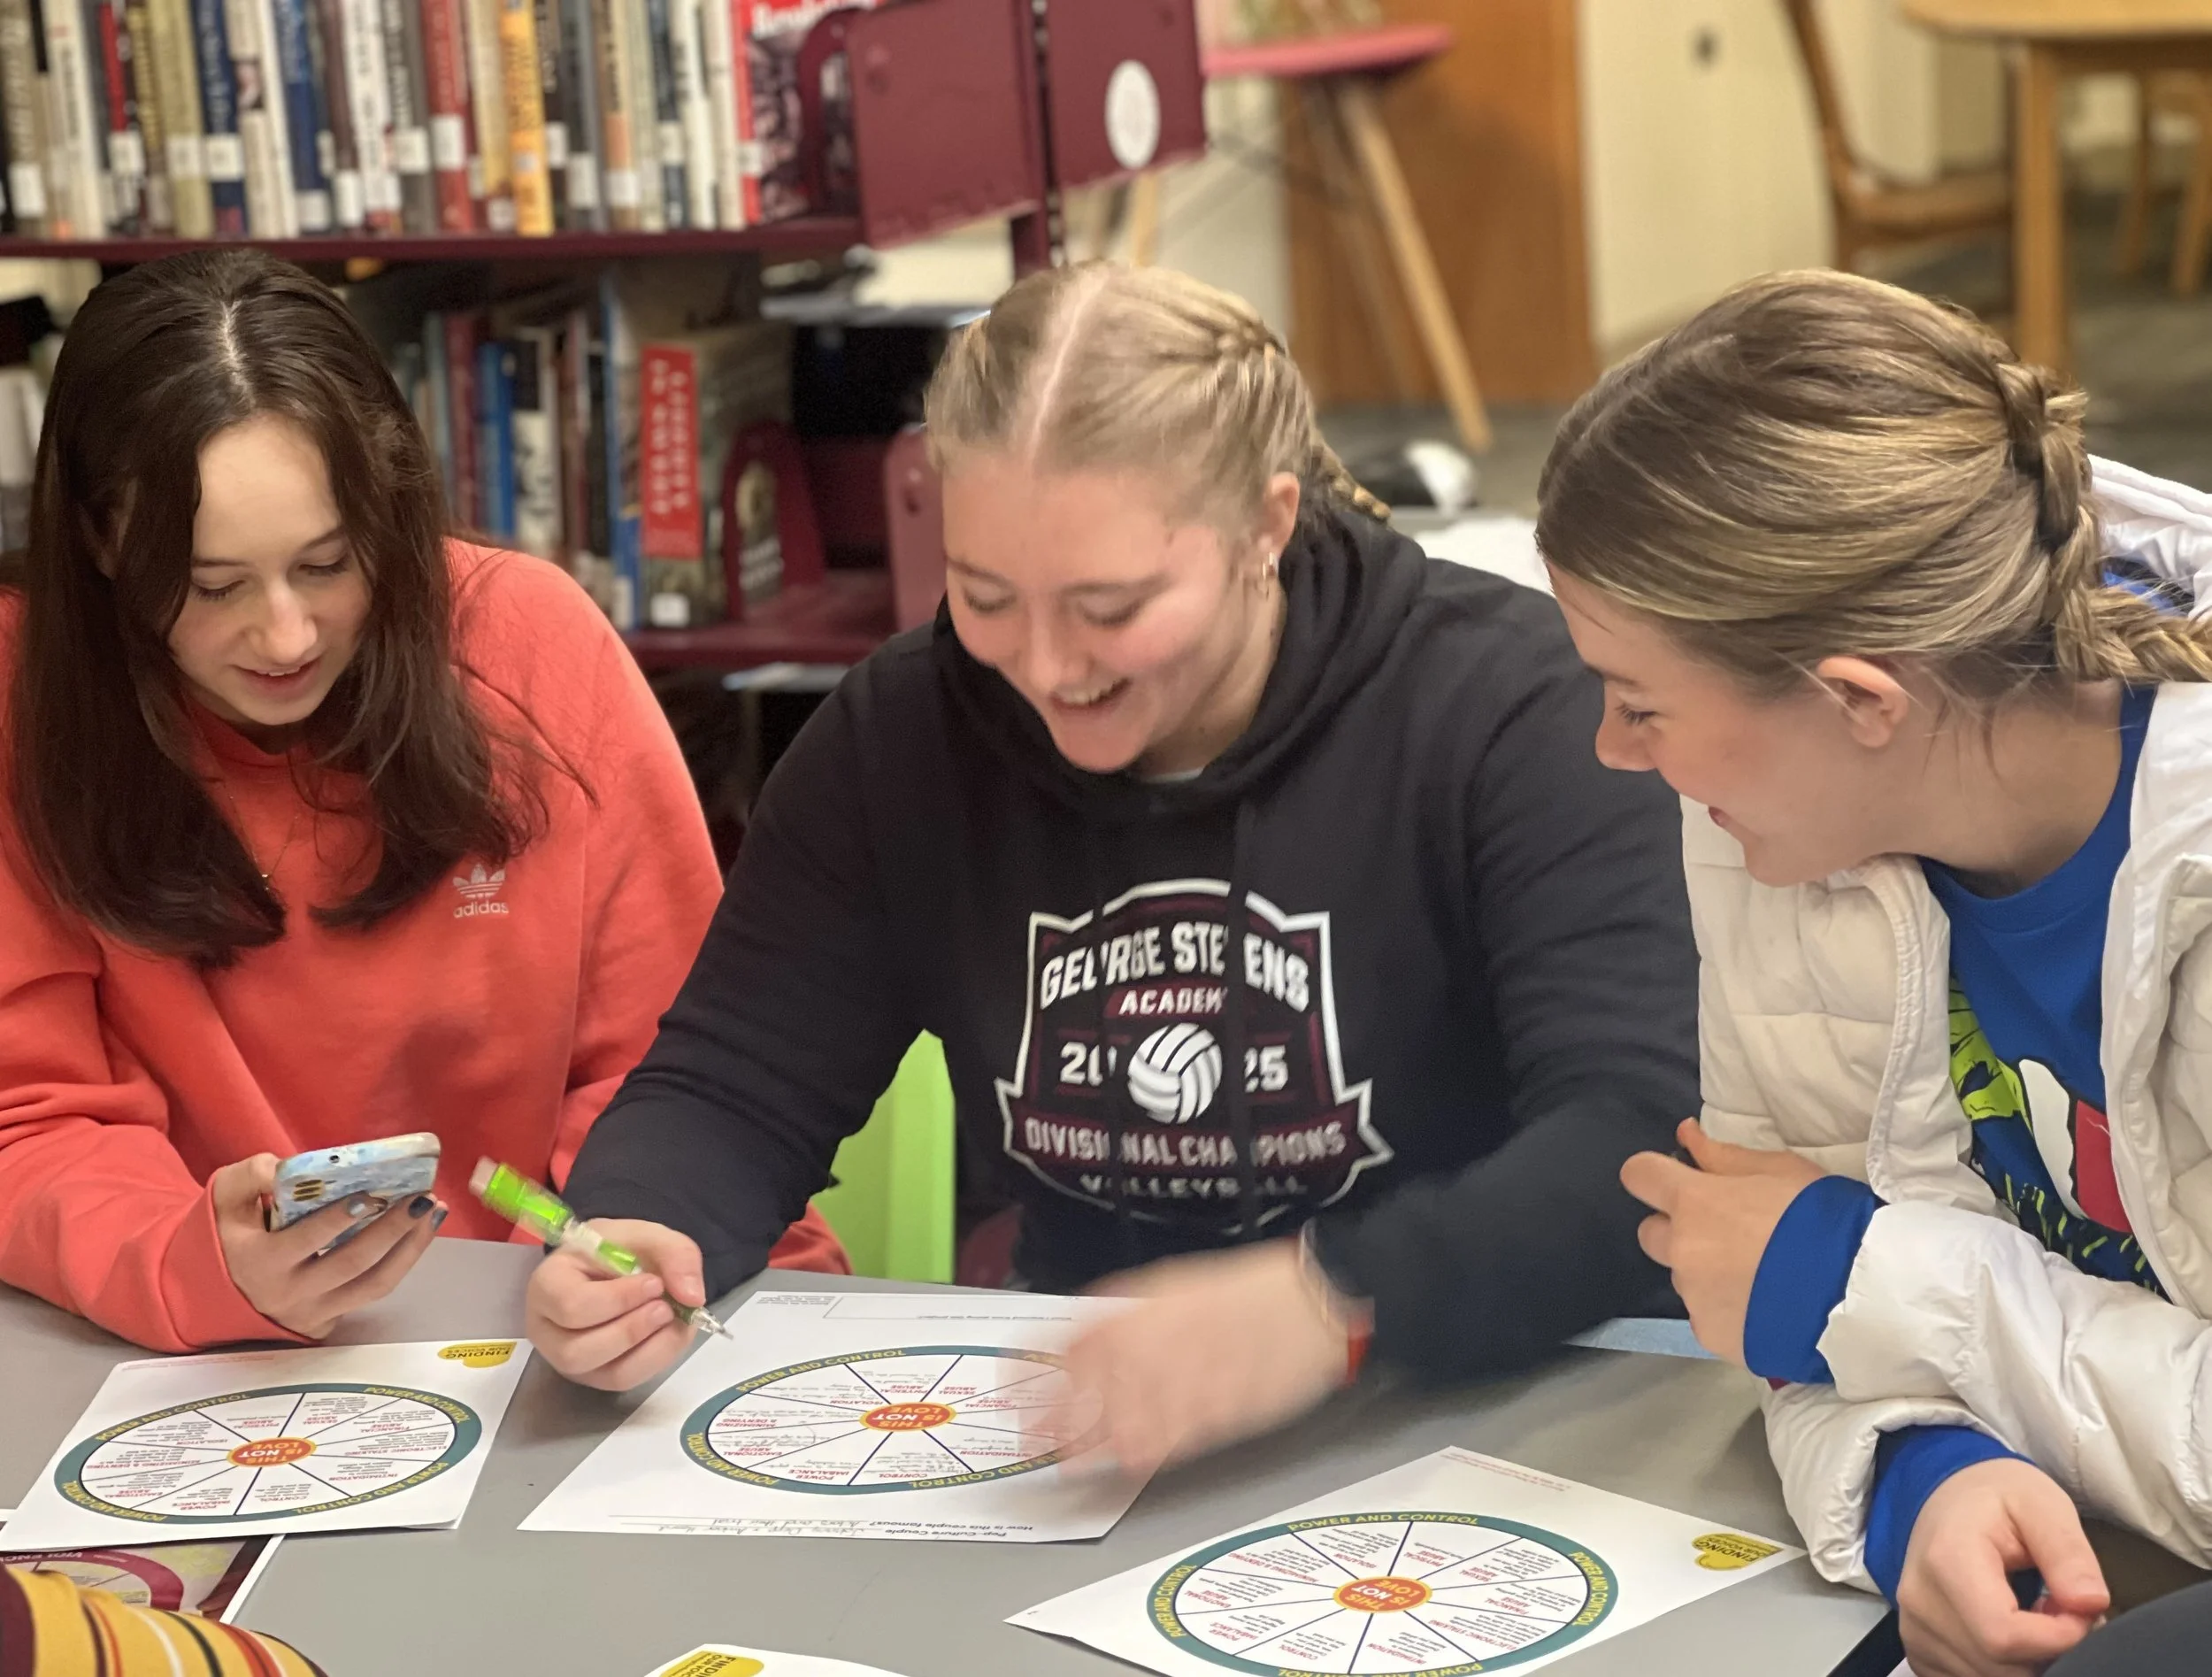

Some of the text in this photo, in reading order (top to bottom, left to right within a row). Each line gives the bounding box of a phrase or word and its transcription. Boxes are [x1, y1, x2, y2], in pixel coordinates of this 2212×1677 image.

[453, 899, 509, 919] adidas
[1171, 921, 1310, 1012] STEENS
[1118, 986, 1228, 1016] ACADEM
[445, 1350, 510, 1359] FINDING
[736, 1371, 787, 1391] POWER
[787, 1362, 822, 1373] AND
[825, 1350, 907, 1365] CONTROL
[94, 1420, 141, 1441] POWER
[141, 1411, 173, 1423] AND
[173, 1394, 250, 1412] CONTROL
[403, 1462, 449, 1485] POWER
[908, 1470, 995, 1489] CONTROL
[373, 1481, 405, 1496] AND
[291, 1494, 373, 1514] CONTROL
[1286, 1513, 1478, 1531] POWER AND CONTROL
[1695, 1541, 1759, 1562] FINDING
[1350, 1584, 1411, 1606] IS NOT
[1374, 1579, 1421, 1597] LOVE
[1344, 1593, 1386, 1611] THIS
[703, 1654, 723, 1665] OUR
[1278, 1643, 1317, 1661] CONTROL
